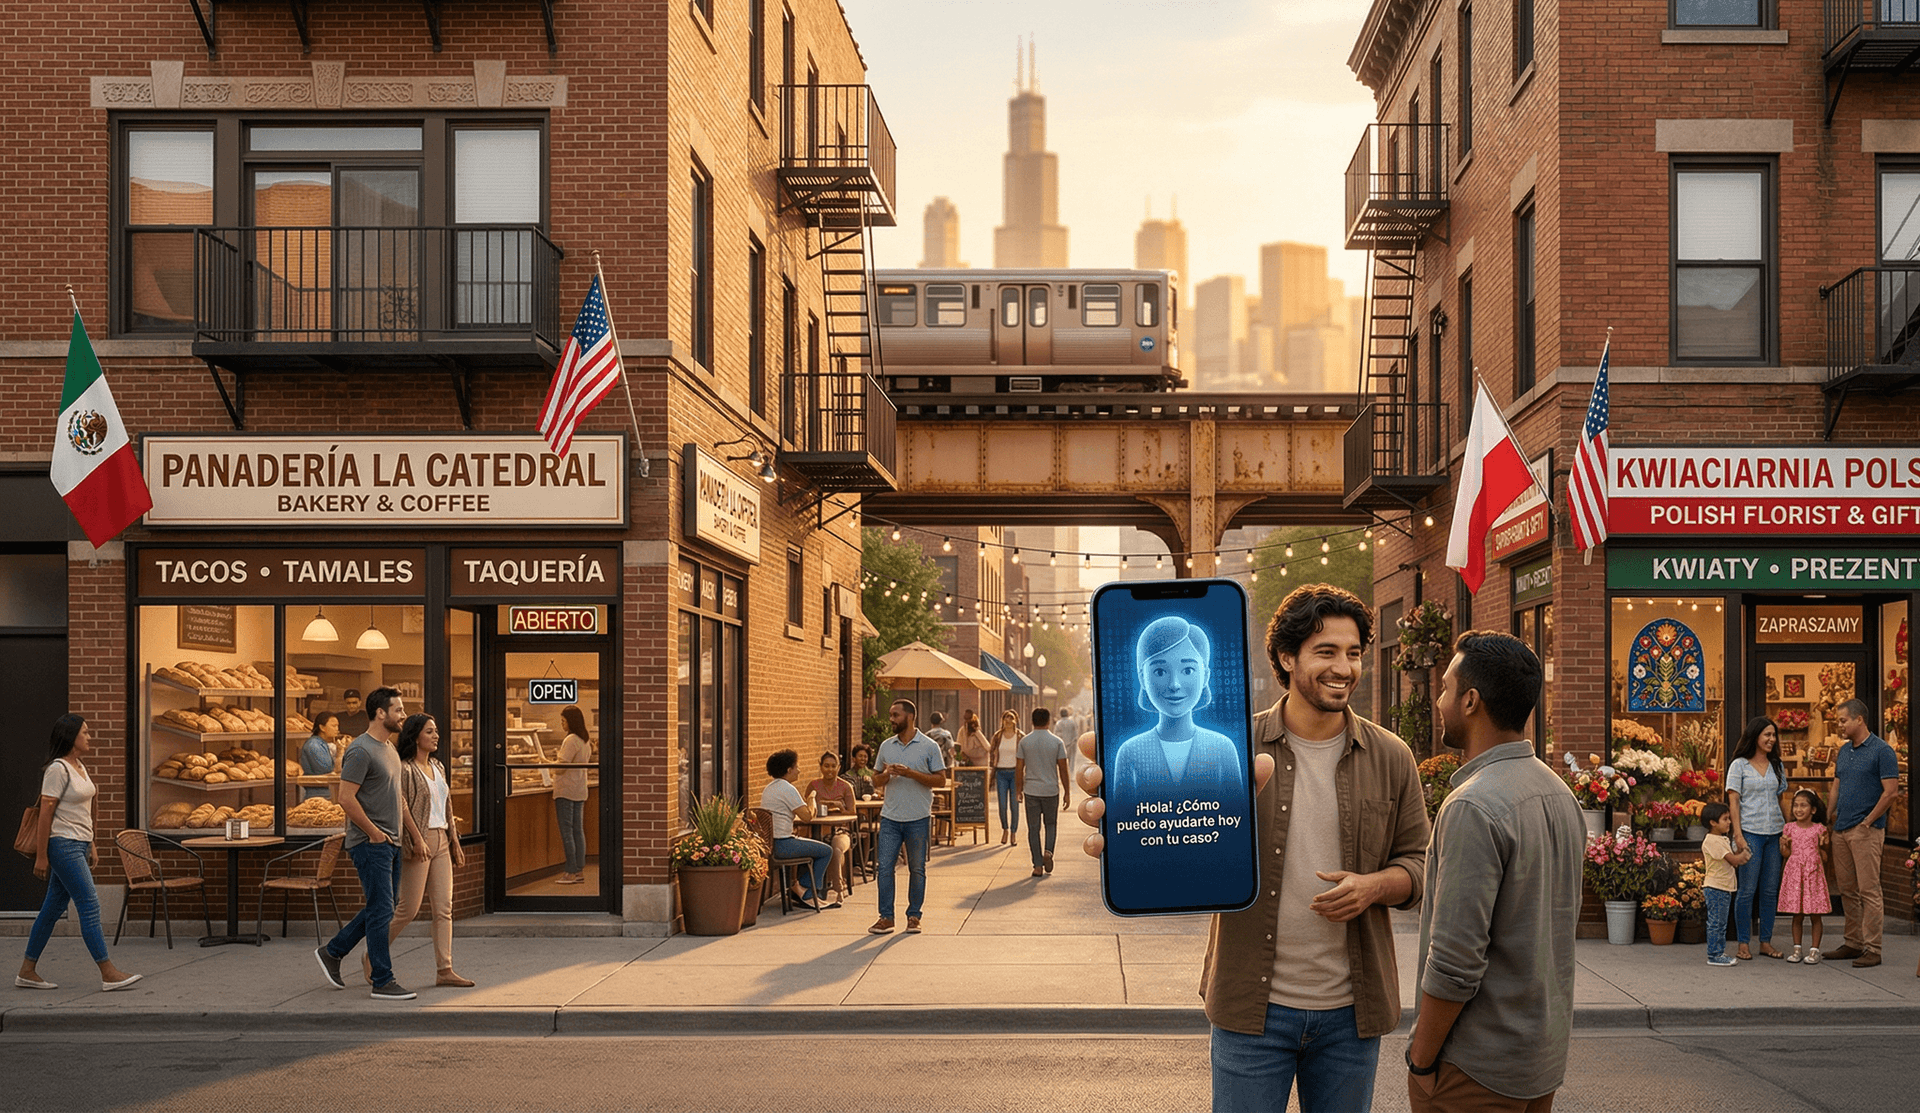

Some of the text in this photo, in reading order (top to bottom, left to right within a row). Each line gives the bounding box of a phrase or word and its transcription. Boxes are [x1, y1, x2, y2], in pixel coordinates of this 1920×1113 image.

[162, 443, 606, 487] PANADERÍA LA CATEDRAL
[1617, 457, 1834, 489] KWIACIARNIA
[277, 494, 490, 513] BAKERY & COFFEE
[1650, 505, 1736, 525] POLISH
[1743, 505, 1842, 525] FLORIST
[1847, 505, 1865, 525] &
[155, 560, 248, 583] TACOS
[282, 560, 413, 583] TAMALES
[463, 553, 605, 586] TAQUERÍA
[1653, 557, 1759, 580] KWIATY
[1791, 557, 1920, 580] PREZENT
[513, 611, 594, 630] ABIERTO
[1759, 616, 1859, 633] ZAPRASZAMY
[532, 684, 574, 700] OPEN
[1136, 799, 1220, 816] ¡Hola! ¿Cómo
[1117, 814, 1241, 834] puedo ayudarte hoy
[1140, 830, 1219, 846] con tu caso?
